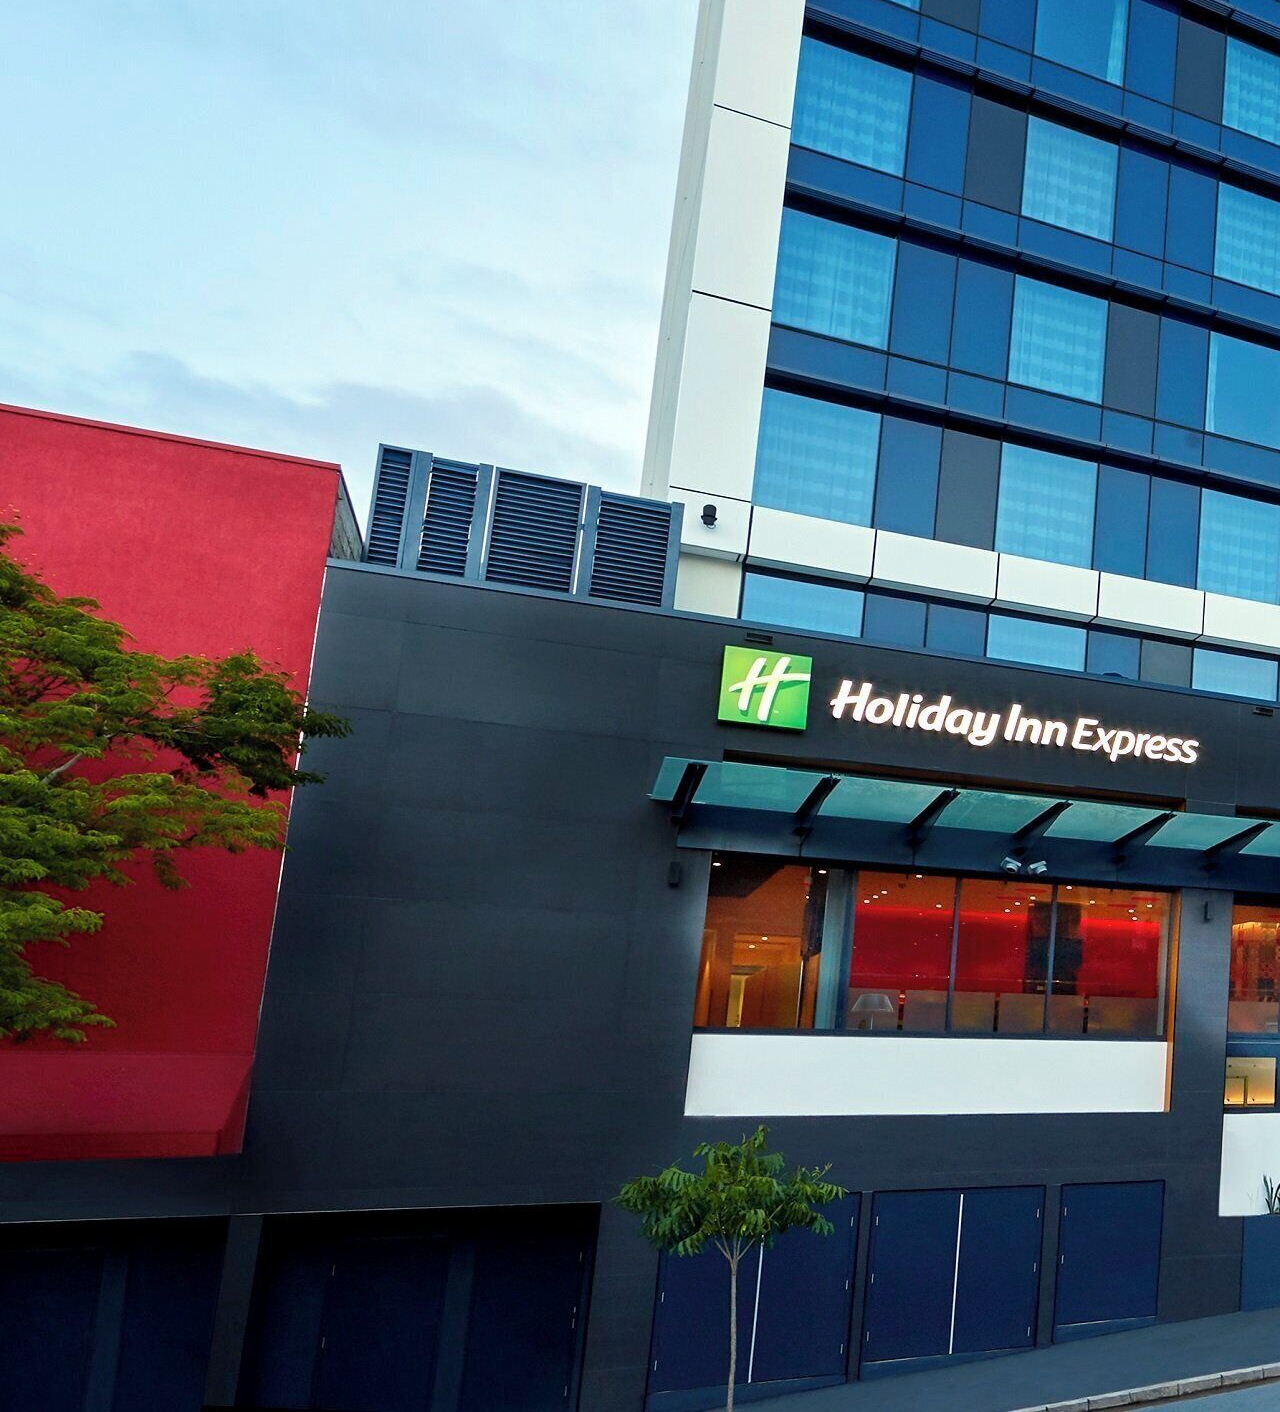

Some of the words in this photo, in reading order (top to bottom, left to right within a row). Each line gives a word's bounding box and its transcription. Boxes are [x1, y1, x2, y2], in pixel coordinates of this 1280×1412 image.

[829, 679, 1000, 747] Holiday
[1004, 703, 1069, 748] Inn
[1071, 718, 1200, 764] Express
